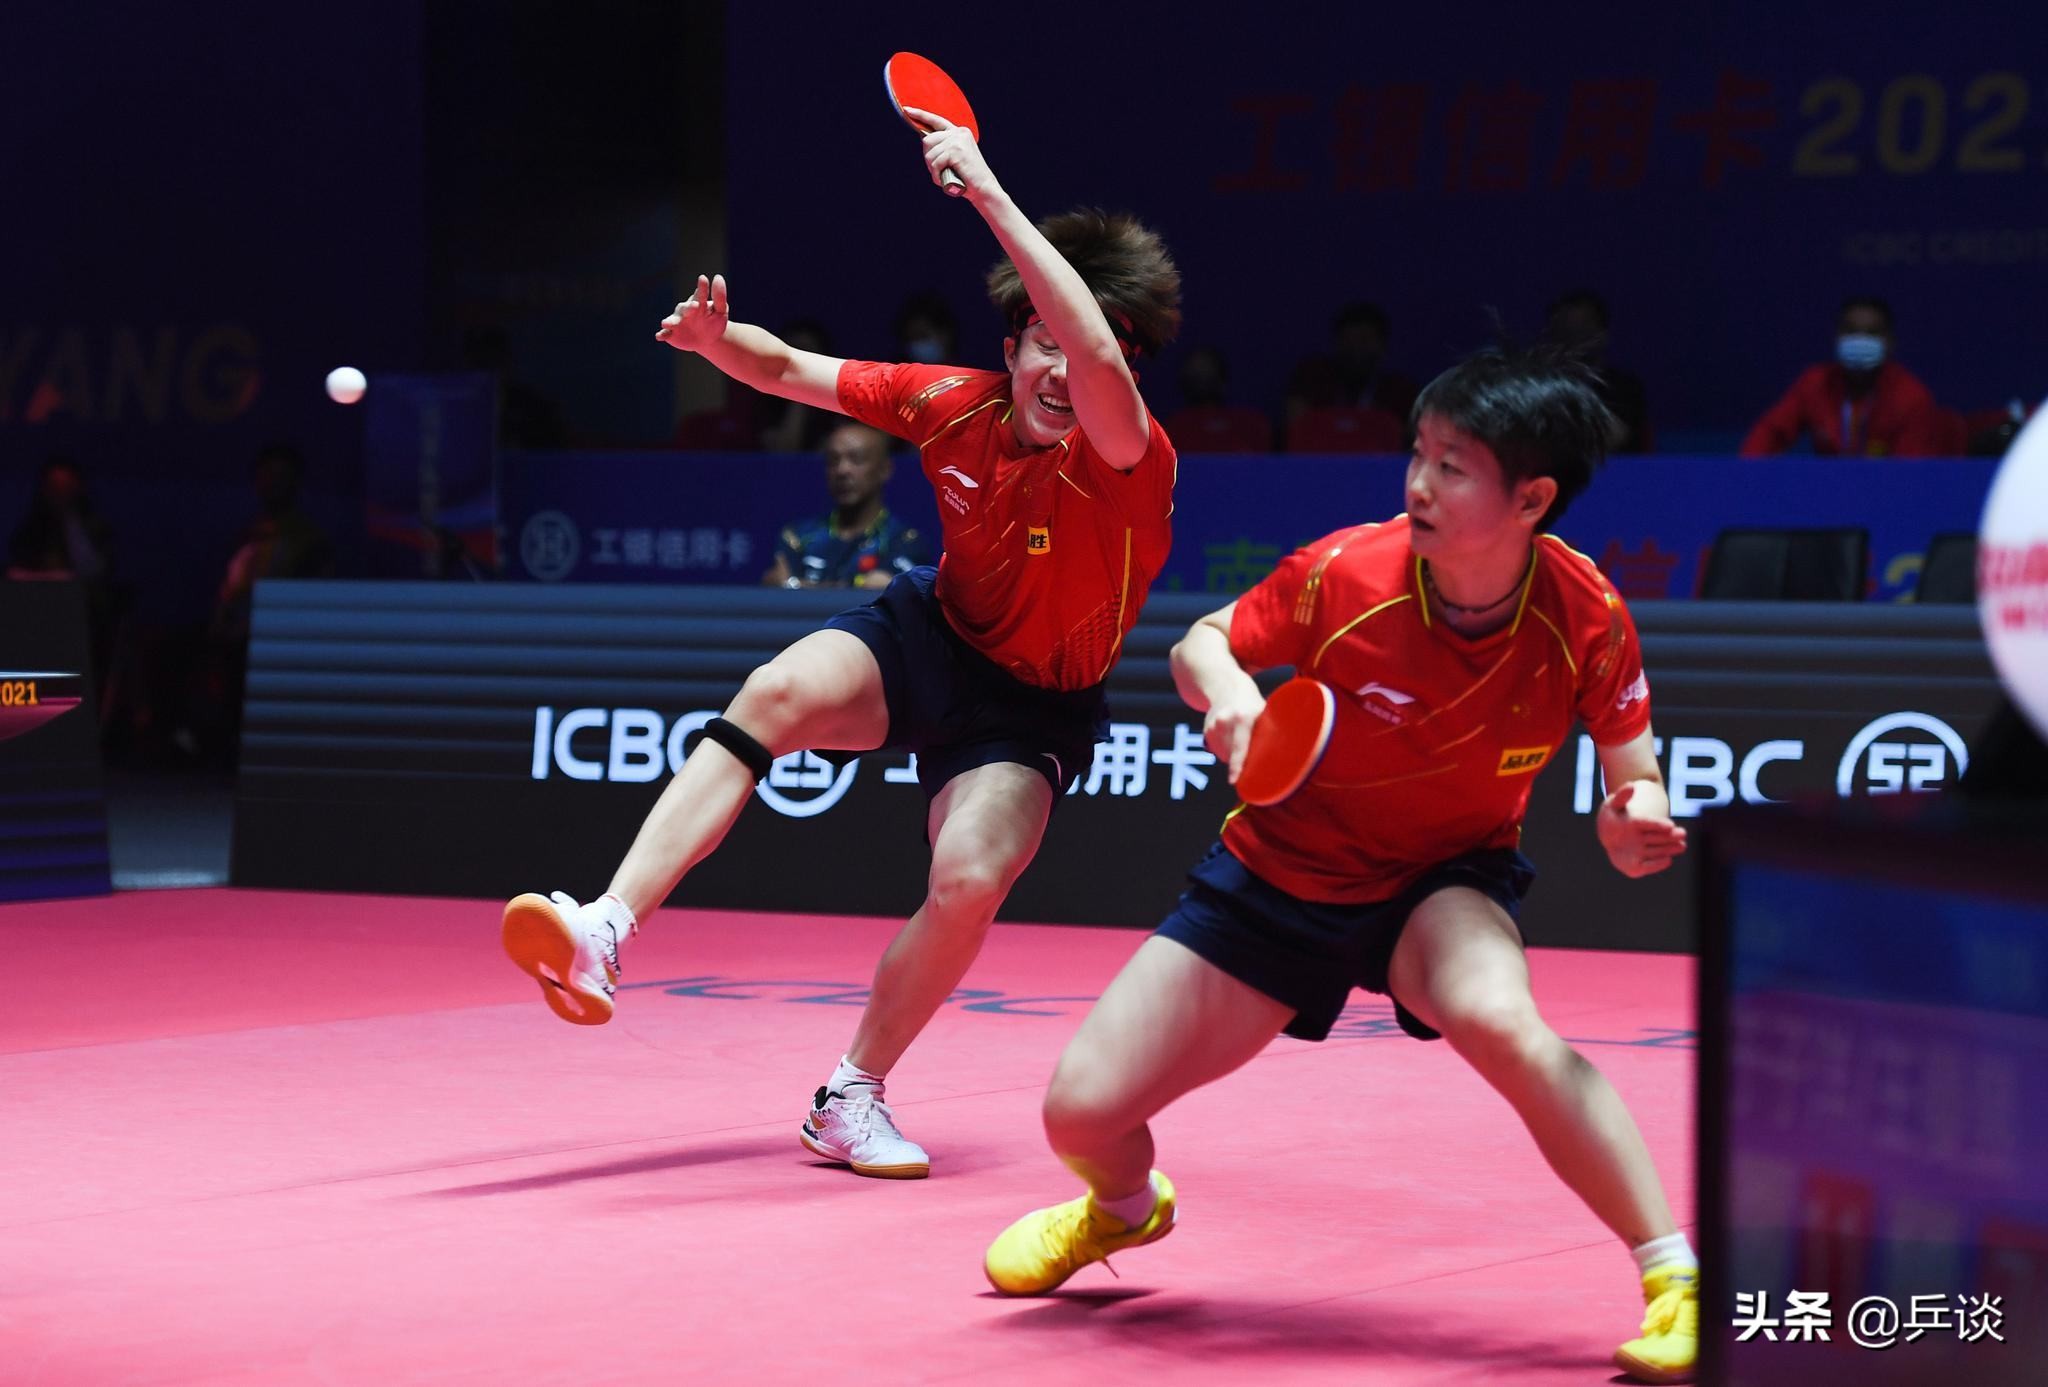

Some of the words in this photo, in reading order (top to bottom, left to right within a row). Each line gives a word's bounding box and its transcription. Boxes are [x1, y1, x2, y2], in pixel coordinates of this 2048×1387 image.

[1794, 73, 2048, 178] 202
[1027, 533, 1047, 549] 胜
[0, 681, 39, 705] 021
[1574, 734, 1804, 817] IBC
